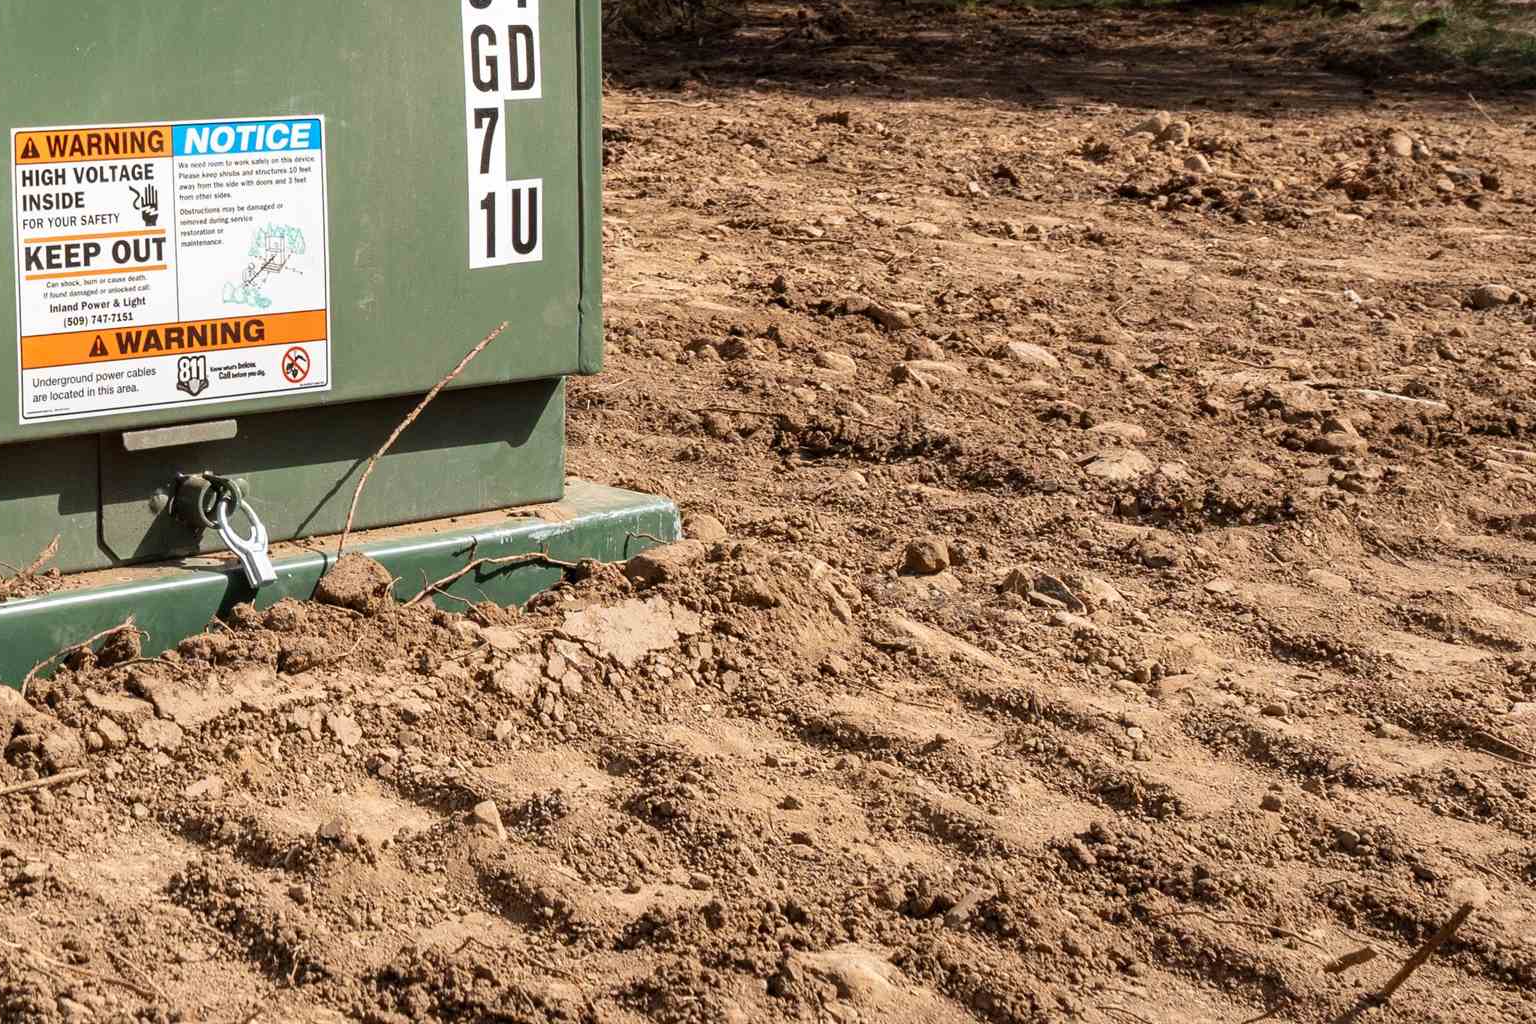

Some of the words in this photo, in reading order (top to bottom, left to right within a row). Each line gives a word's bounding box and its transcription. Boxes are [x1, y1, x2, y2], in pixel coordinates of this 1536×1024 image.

[470, 24, 536, 93] GD
[46, 129, 164, 158] WARNING
[183, 122, 312, 154] NOTICE
[473, 107, 499, 175] 7
[178, 161, 188, 169] We
[191, 161, 206, 169] need
[225, 159, 232, 167] to
[251, 157, 269, 166] safely
[280, 155, 292, 164] this
[21, 168, 66, 187] HIGH
[74, 163, 154, 184] VOLTAGE
[201, 171, 218, 179] keep
[219, 169, 240, 177] shrubs
[242, 168, 254, 176] and
[255, 167, 287, 176] structures
[289, 166, 298, 174] 10
[299, 165, 312, 174] feet
[179, 184, 195, 192] away
[225, 180, 239, 188] side
[255, 178, 273, 186] doors
[275, 177, 287, 185] and
[294, 176, 307, 184] feet
[22, 191, 85, 212] INSIDE
[179, 193, 194, 201] from
[195, 192, 212, 200] other
[179, 207, 221, 216] Obstructions
[222, 206, 236, 214] may
[246, 203, 276, 212] damaged
[22, 218, 45, 230] FOR
[48, 215, 77, 227] YOUR
[80, 213, 120, 226] SAFETY
[179, 218, 207, 226] removed
[480, 186, 538, 259] 1U
[180, 228, 216, 237] restoration
[24, 242, 102, 272] KEEP
[111, 237, 167, 265] OUT
[46, 280, 59, 289] Can
[83, 278, 98, 286] burn
[107, 276, 126, 284] cause
[49, 290, 68, 299] found
[69, 288, 99, 297] damaged
[107, 284, 137, 294] unlocked
[49, 303, 79, 314] Inland
[81, 300, 110, 311] Power
[112, 298, 121, 309] &
[123, 296, 147, 309] Light
[64, 316, 89, 328] (509)
[91, 311, 135, 324] 747-7151
[115, 319, 266, 356] WARNING
[31, 372, 95, 389] Underground
[95, 371, 125, 383] power
[126, 367, 157, 379] cables
[178, 355, 206, 383] 811
[218, 371, 231, 380] Call
[231, 371, 247, 379] before
[32, 393, 48, 403] are
[49, 386, 85, 401] located
[87, 385, 96, 397] in
[97, 383, 115, 396] this
[116, 382, 140, 395] area.
